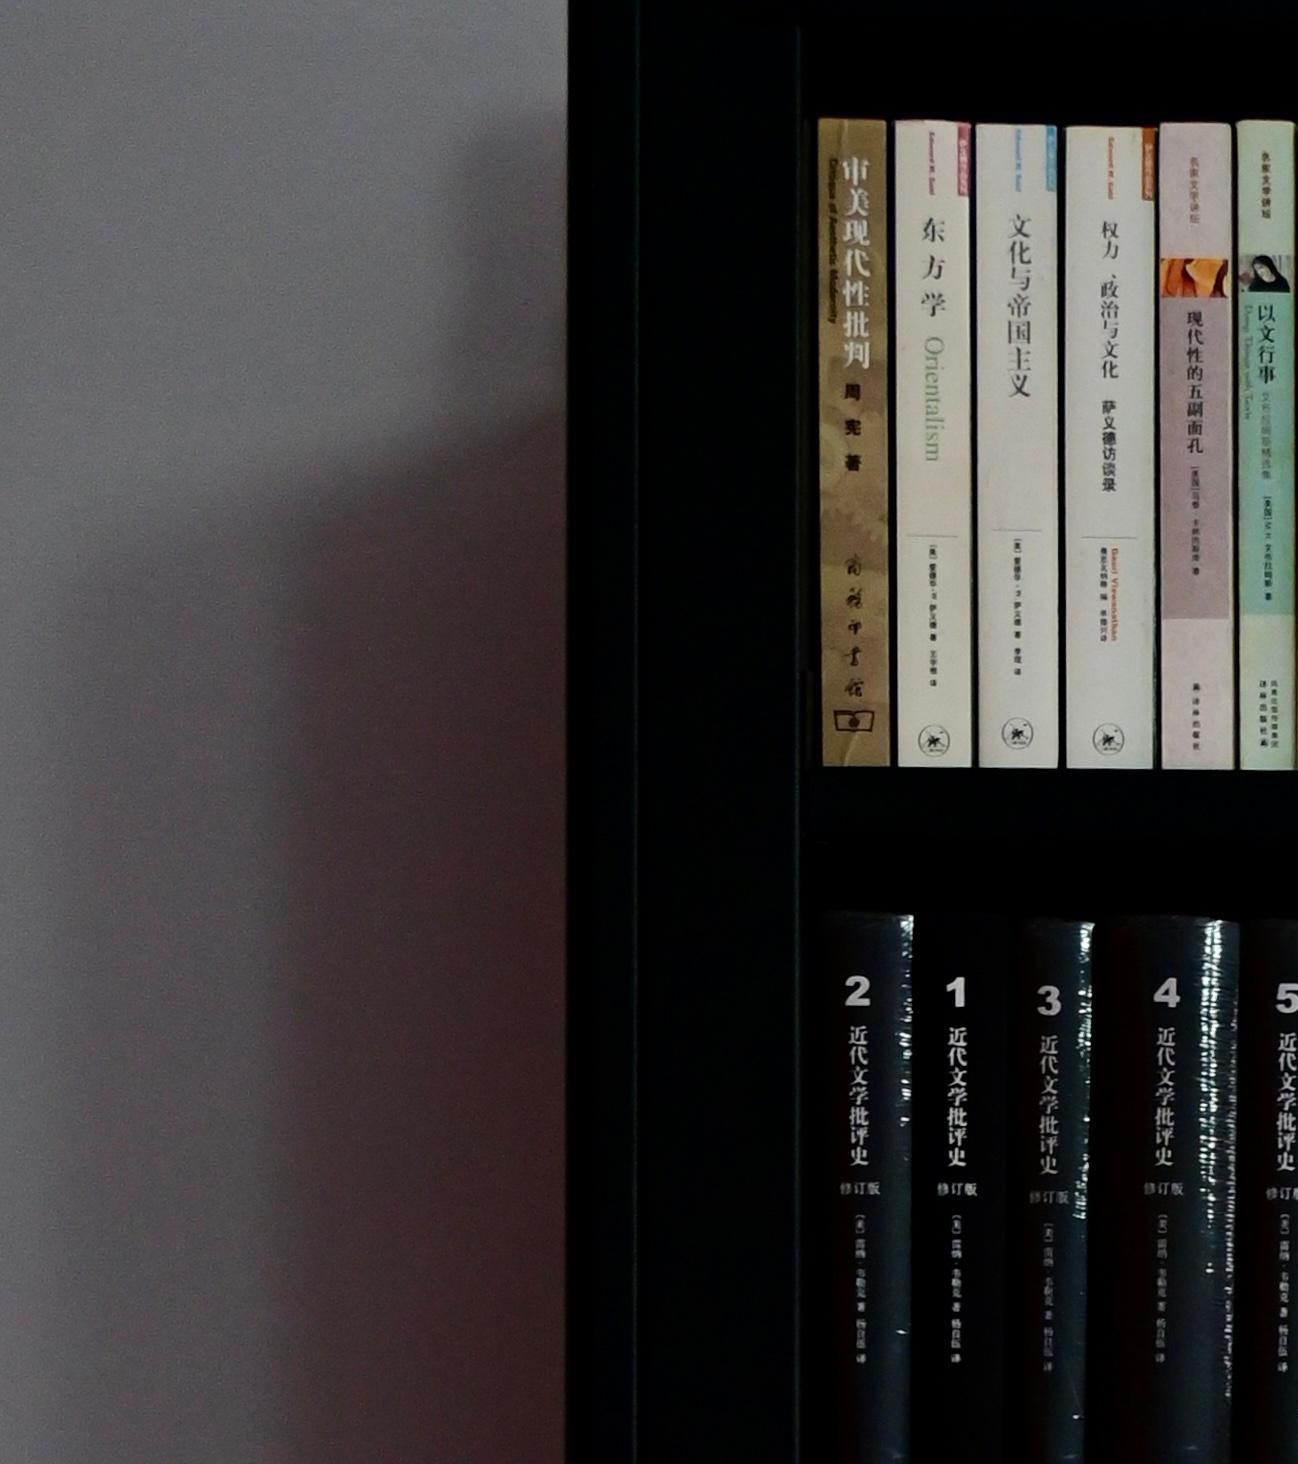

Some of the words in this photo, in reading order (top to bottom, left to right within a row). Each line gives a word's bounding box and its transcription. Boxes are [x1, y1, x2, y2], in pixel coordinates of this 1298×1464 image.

[842, 156, 870, 370] 审美现代性批判
[922, 217, 946, 318] 东方学
[1007, 214, 1032, 398] 文化与帝国主义
[1100, 220, 1119, 380] 权力、政治与文化
[924, 336, 945, 462] Orientalism
[1101, 399, 1117, 493] 萨义德访谈录
[1186, 310, 1204, 454] 现代性的五副面孔
[844, 974, 871, 1007] 2
[945, 976, 966, 1008] 1
[1037, 984, 1062, 1017] 3
[1152, 976, 1181, 1009] 4
[849, 1025, 869, 1166] 近代文学批评史
[948, 1026, 968, 1167] 近代文学批评史
[1039, 1034, 1059, 1175] 近代文学批评史
[1155, 1026, 1176, 1167] 近代文学批评史
